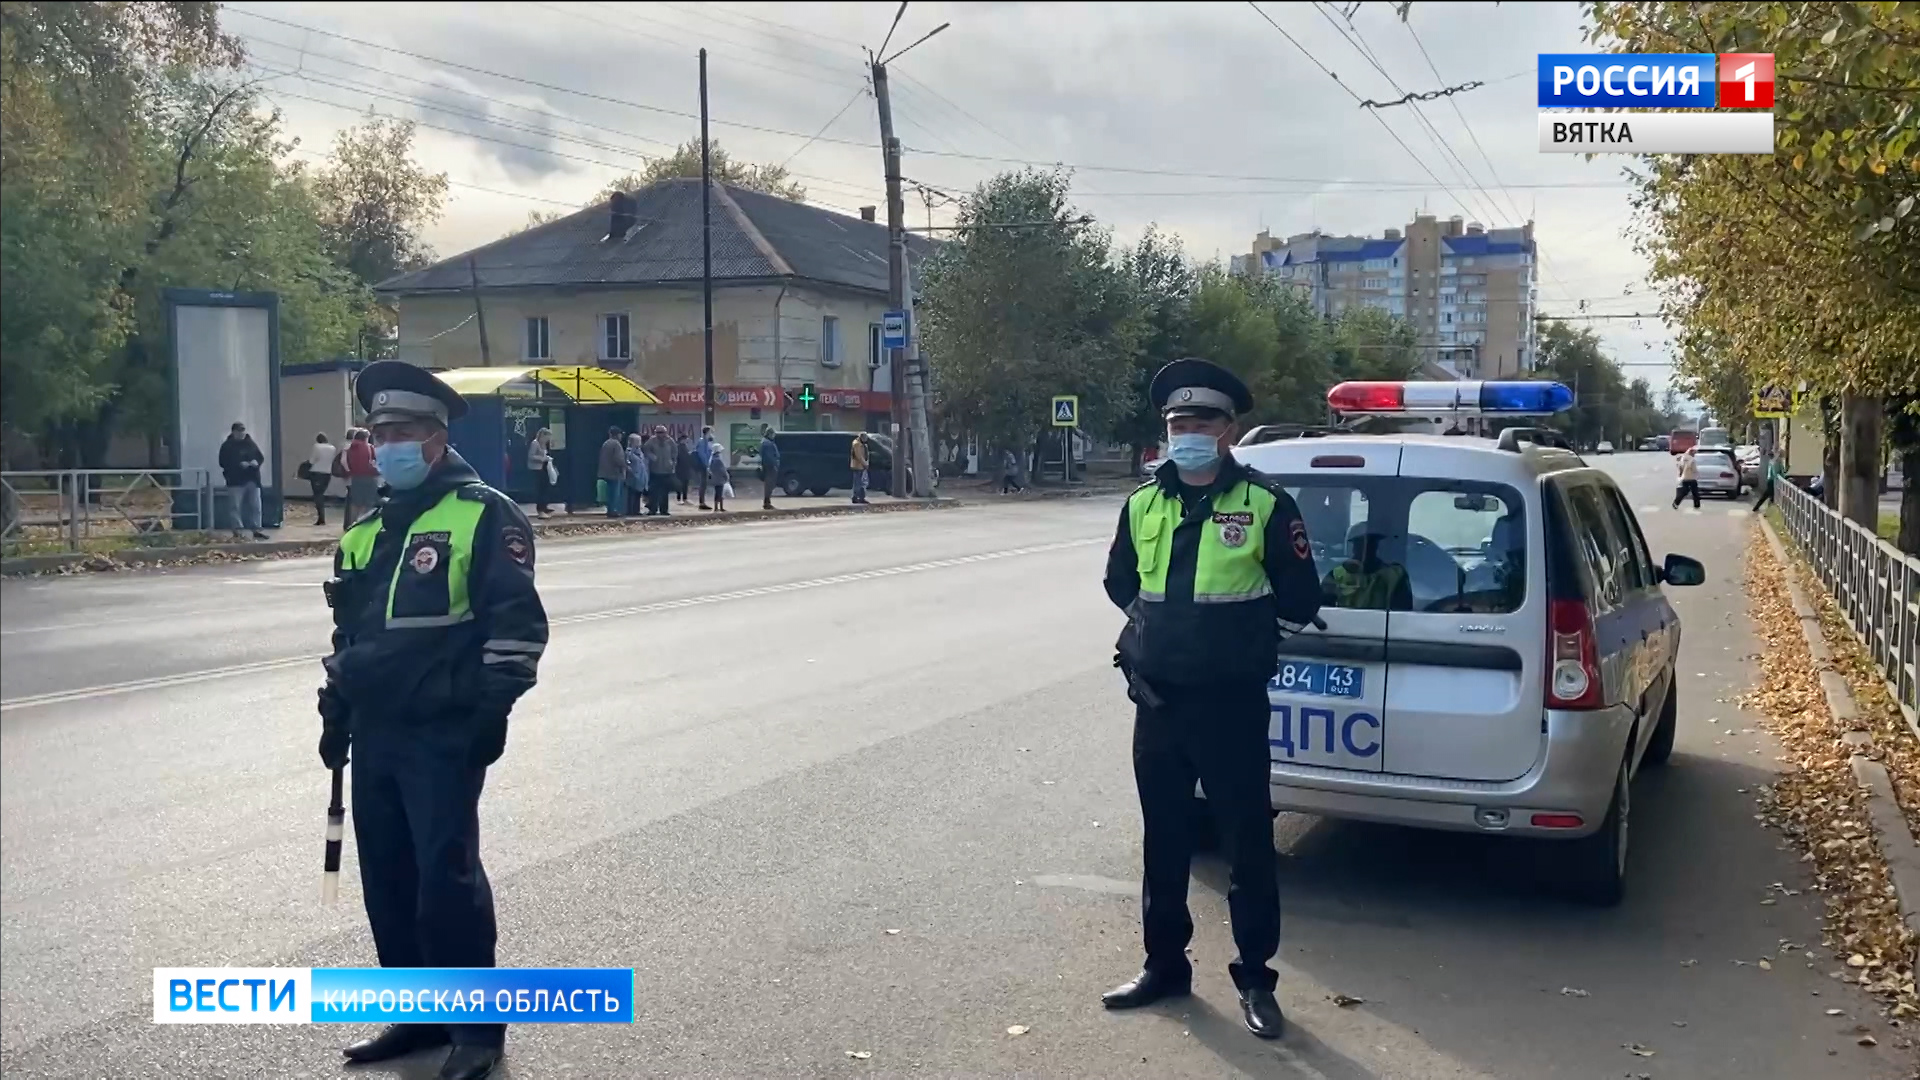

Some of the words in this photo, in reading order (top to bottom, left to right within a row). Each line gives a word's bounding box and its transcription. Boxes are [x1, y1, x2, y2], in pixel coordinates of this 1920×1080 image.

[669, 391, 705, 402] АПТЕК
[728, 391, 758, 402] ВИТА
[1329, 667, 1354, 687] 43
[1270, 704, 1380, 758] ДПС
